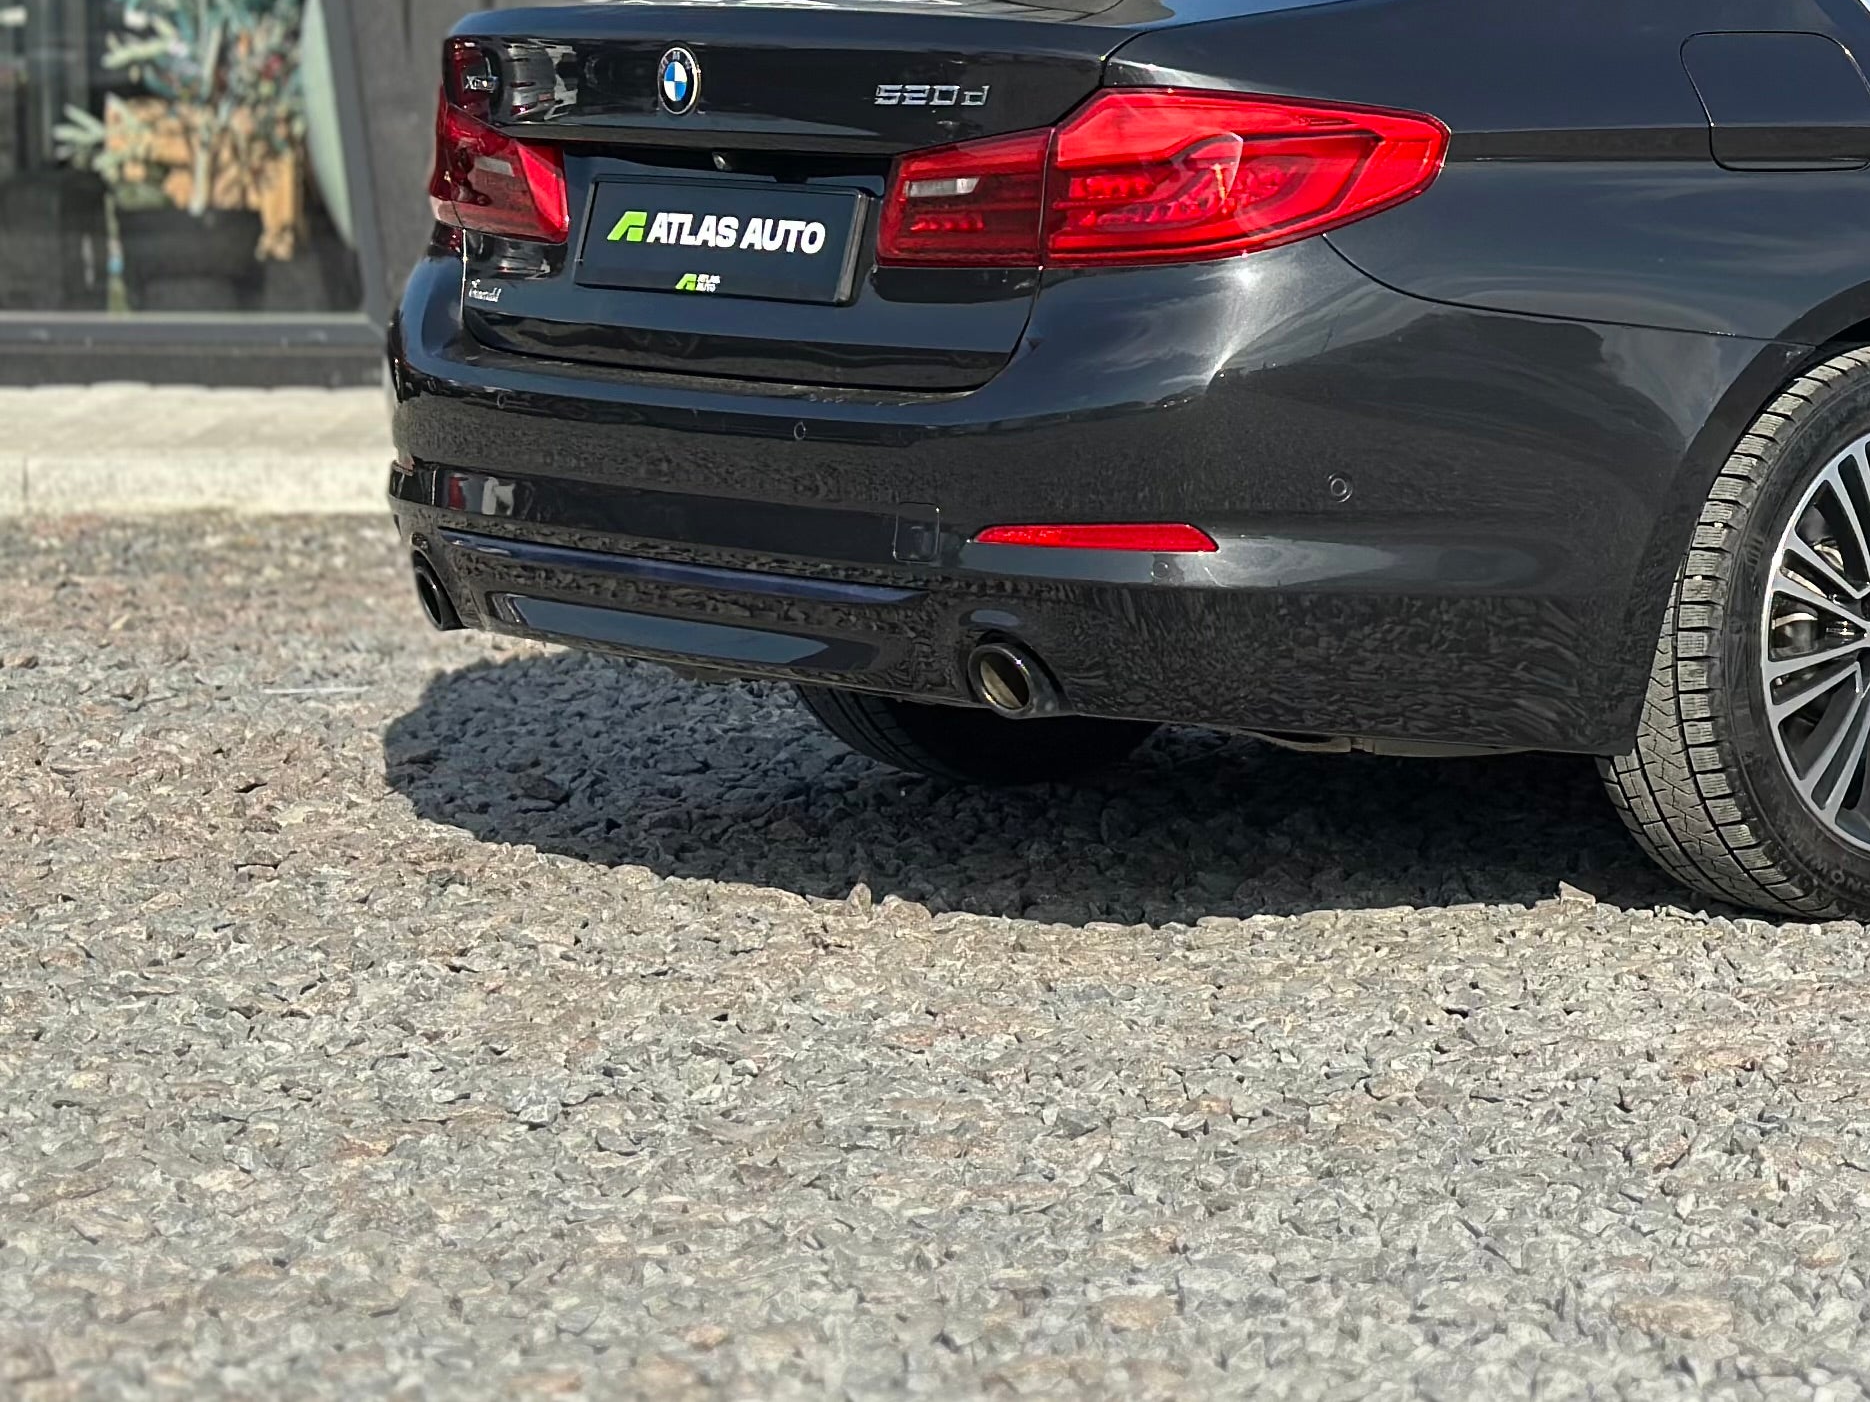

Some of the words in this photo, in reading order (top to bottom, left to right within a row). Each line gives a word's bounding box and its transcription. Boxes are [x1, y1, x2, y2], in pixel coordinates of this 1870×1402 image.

[874, 84, 990, 106] 520d
[646, 211, 739, 249] ATLAS
[739, 217, 826, 255] AUTO
